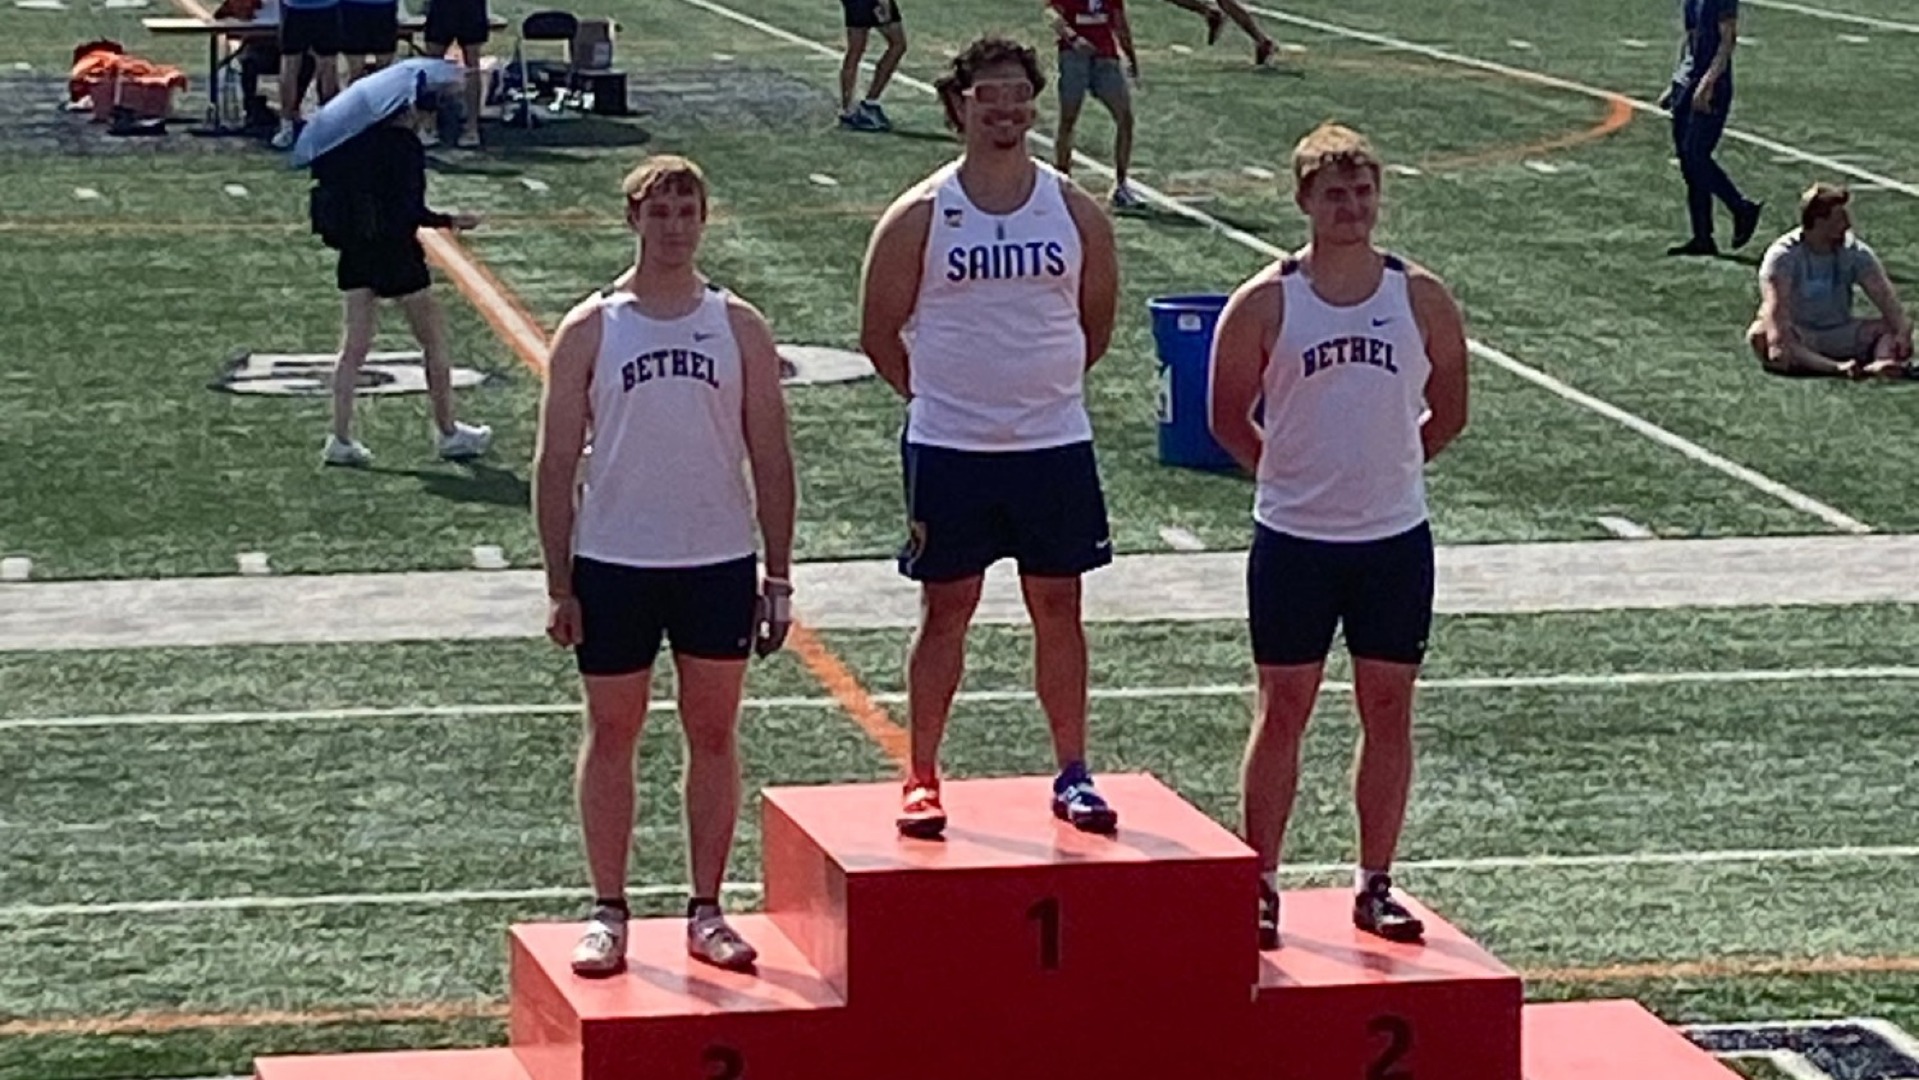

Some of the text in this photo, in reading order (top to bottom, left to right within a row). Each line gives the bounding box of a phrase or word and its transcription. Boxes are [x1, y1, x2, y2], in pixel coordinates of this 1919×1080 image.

[946, 241, 1066, 281] SAINTS
[621, 347, 720, 393] BETHEL
[1302, 335, 1399, 378] BETHEL
[1024, 897, 1061, 971] 1
[1365, 1014, 1415, 1080] 2
